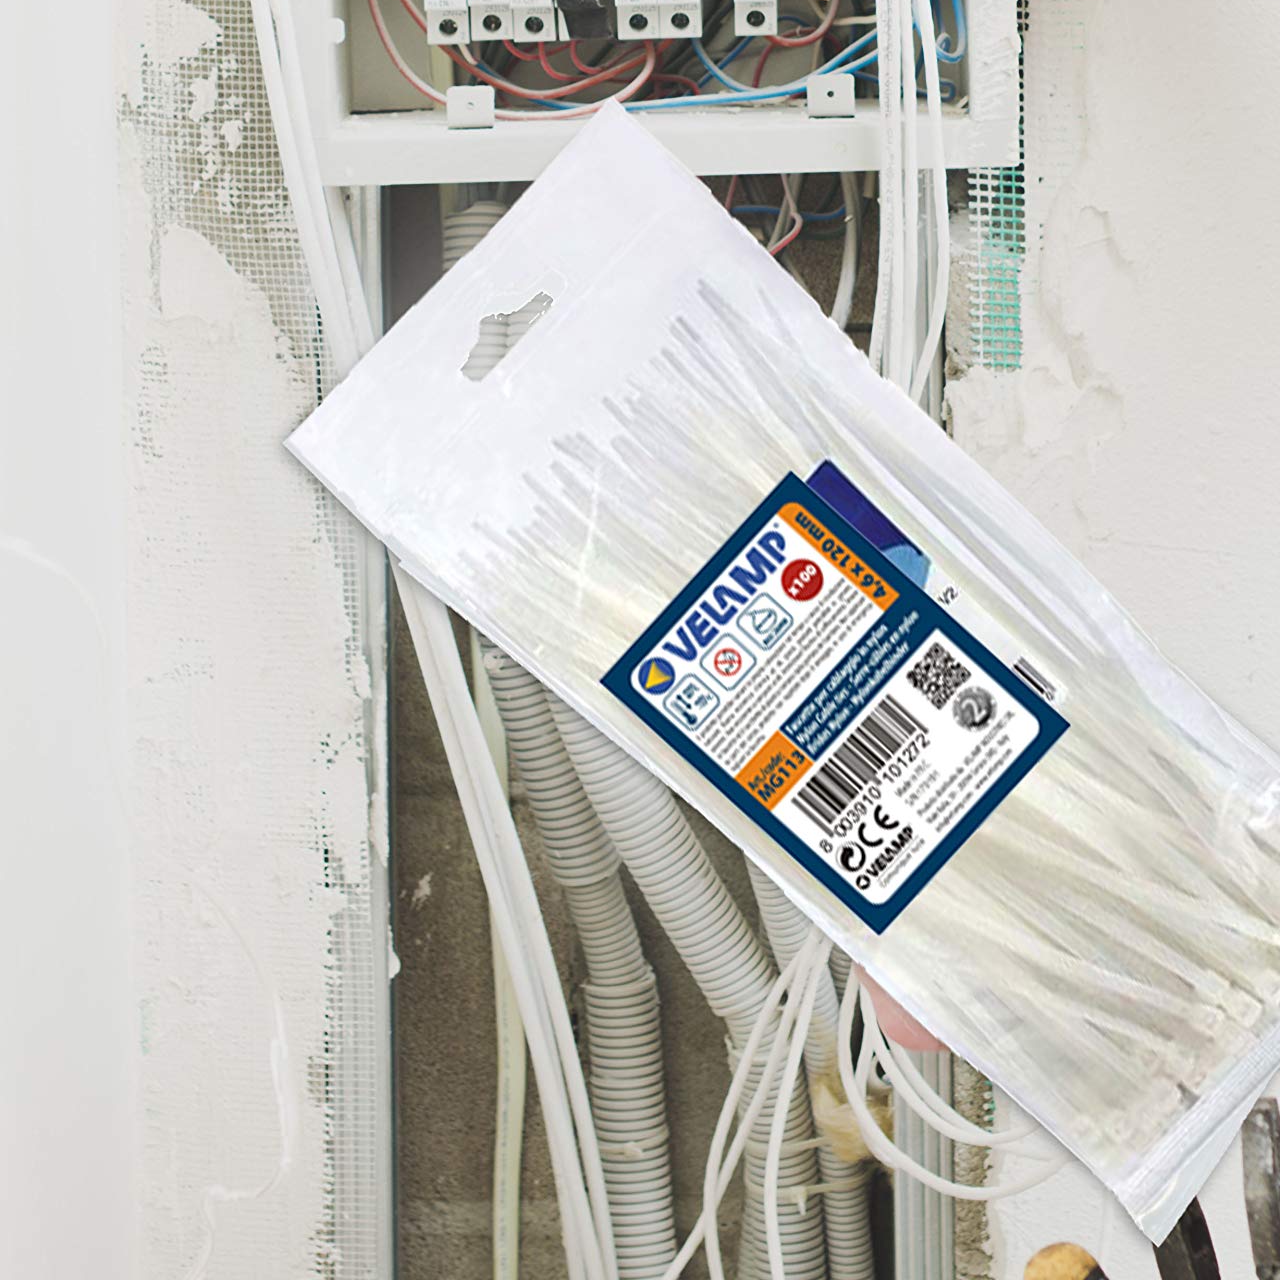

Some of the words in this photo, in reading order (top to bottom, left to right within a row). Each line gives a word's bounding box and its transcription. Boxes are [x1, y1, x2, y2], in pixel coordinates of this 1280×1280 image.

[794, 511, 824, 540] mm
[821, 538, 850, 567] 120
[662, 531, 785, 660] VELAMP
[787, 564, 816, 596] x100
[757, 750, 805, 801] MG113
[819, 839, 833, 853] 8
[829, 786, 881, 837] 003910
[882, 733, 930, 782] 101272
[866, 826, 912, 876] VELAMP
